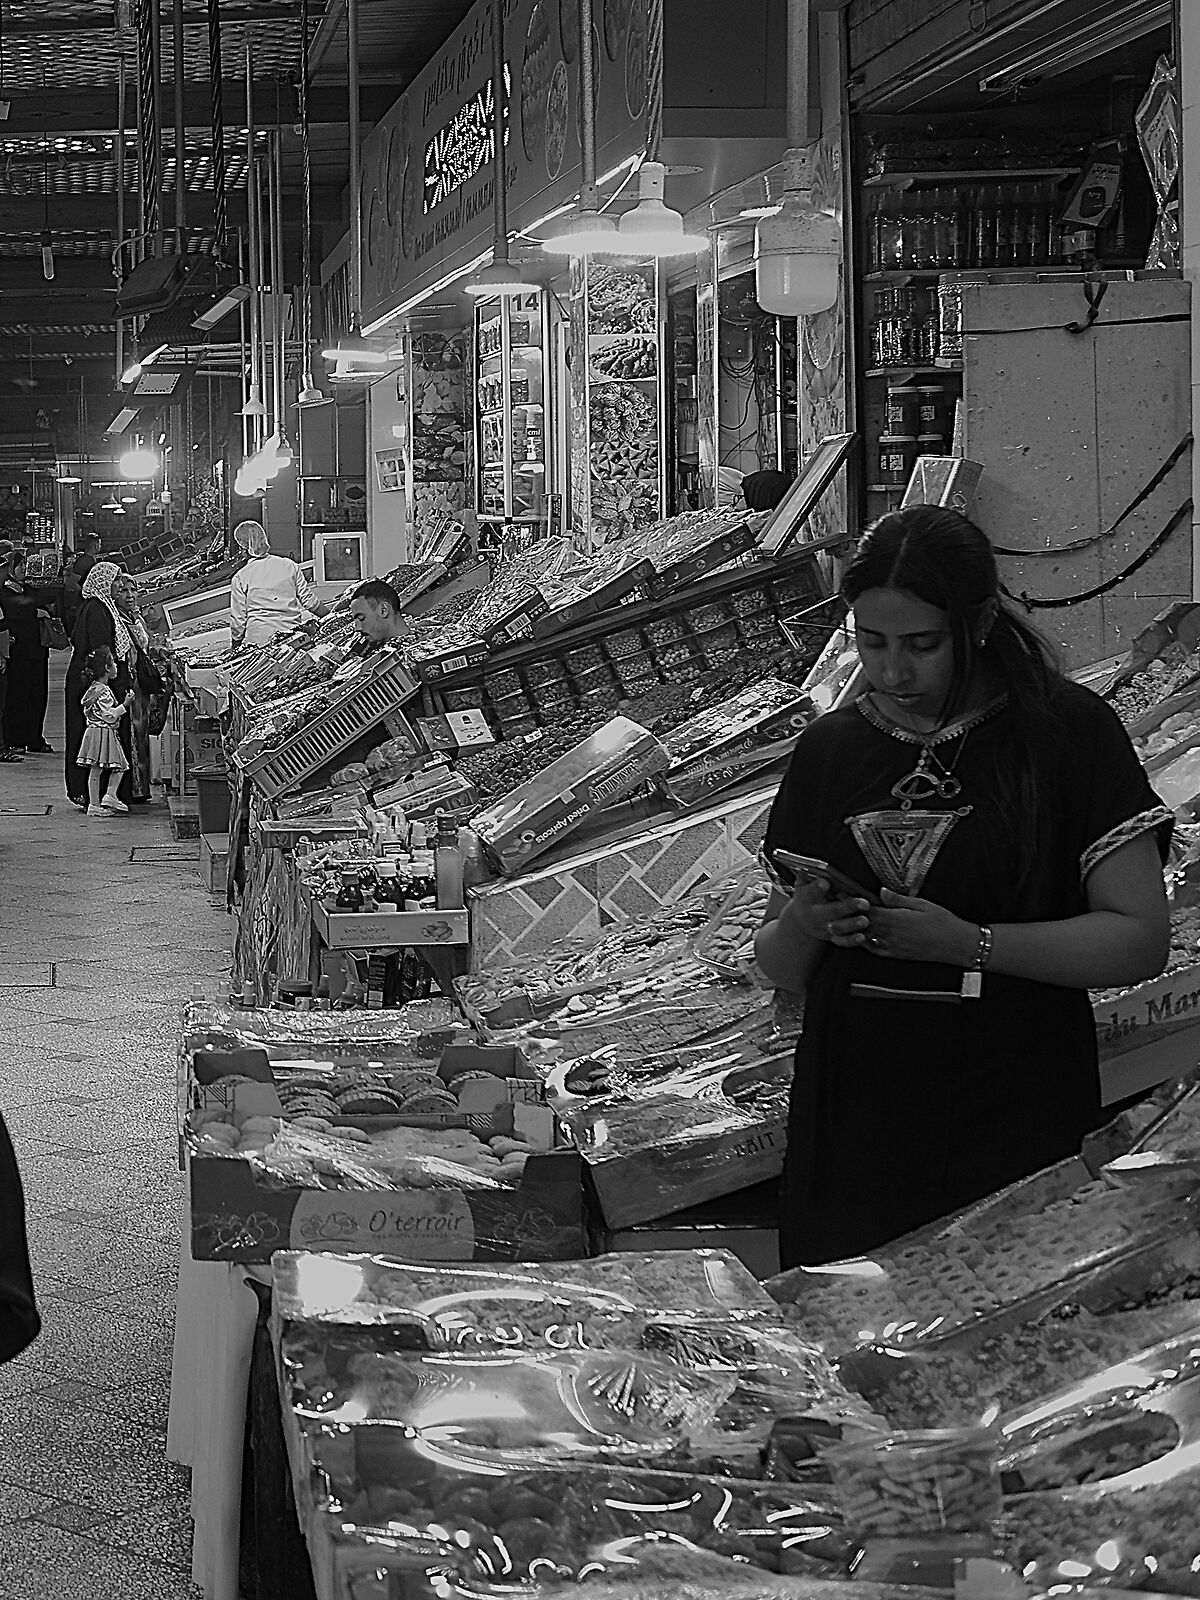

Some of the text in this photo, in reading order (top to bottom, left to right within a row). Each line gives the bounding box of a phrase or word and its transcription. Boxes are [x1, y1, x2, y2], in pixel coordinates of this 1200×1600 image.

[512, 293, 539, 311] 14
[535, 804, 592, 843] Dried Apricots
[369, 1210, 465, 1233] O'terroir
